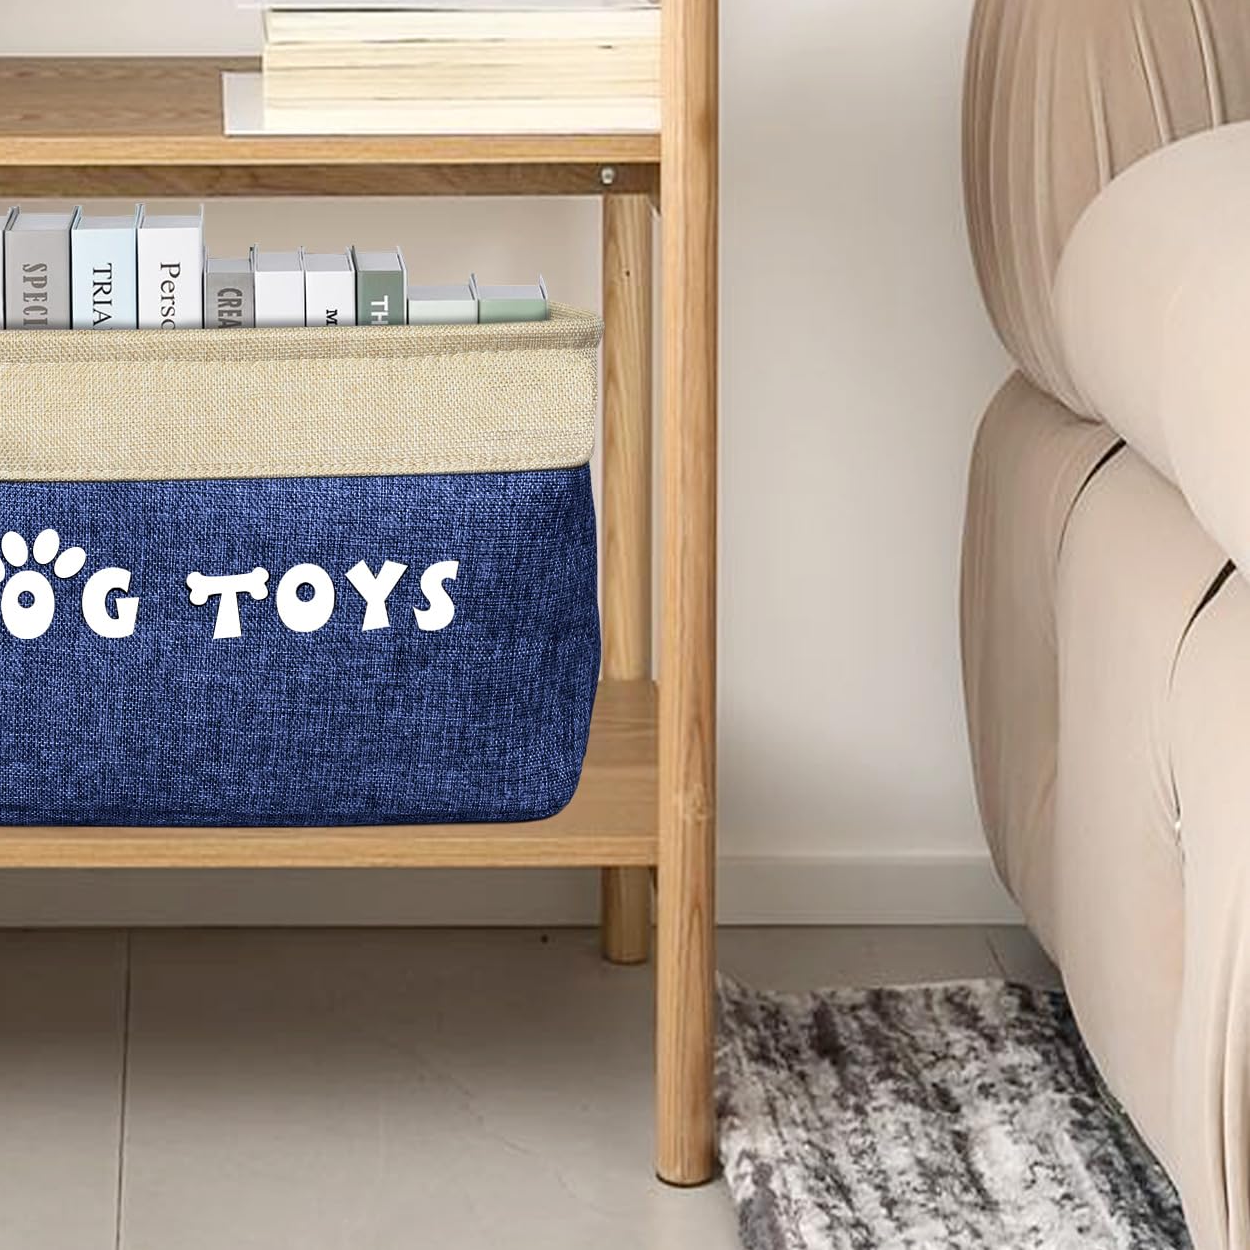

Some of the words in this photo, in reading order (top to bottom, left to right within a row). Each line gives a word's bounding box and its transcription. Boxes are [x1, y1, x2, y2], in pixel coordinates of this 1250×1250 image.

[22, 262, 48, 326] SPECI
[92, 262, 113, 329] TRIA
[217, 287, 243, 328] CREA
[371, 295, 388, 326] TH
[186, 559, 459, 641] TOYS
